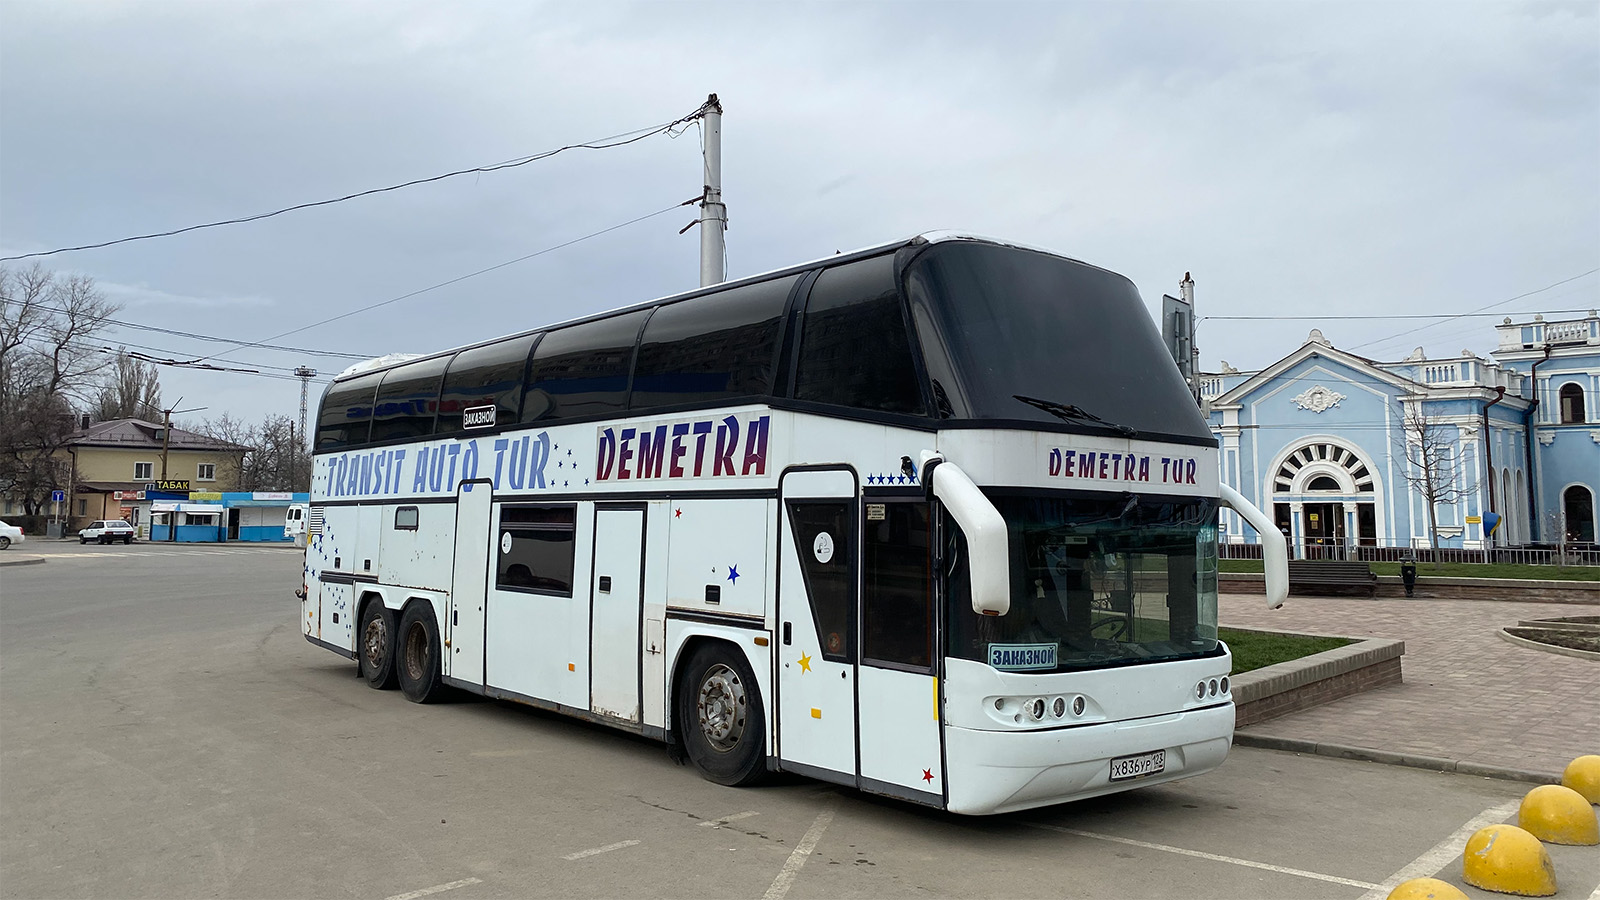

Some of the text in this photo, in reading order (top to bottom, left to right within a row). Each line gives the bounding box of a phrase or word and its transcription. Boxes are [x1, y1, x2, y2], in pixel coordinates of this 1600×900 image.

[463, 407, 496, 427] ЗАКАЗНОЙ
[596, 413, 770, 481] DEMETRA
[326, 431, 551, 497] TRANSIT AUTO TUR
[1049, 447, 1198, 485] DEMETRA TUR
[156, 480, 189, 490] ТАБАК
[992, 646, 1055, 666] ЗАКАЗНОЙ
[1114, 752, 1164, 776] Х836УР 123
